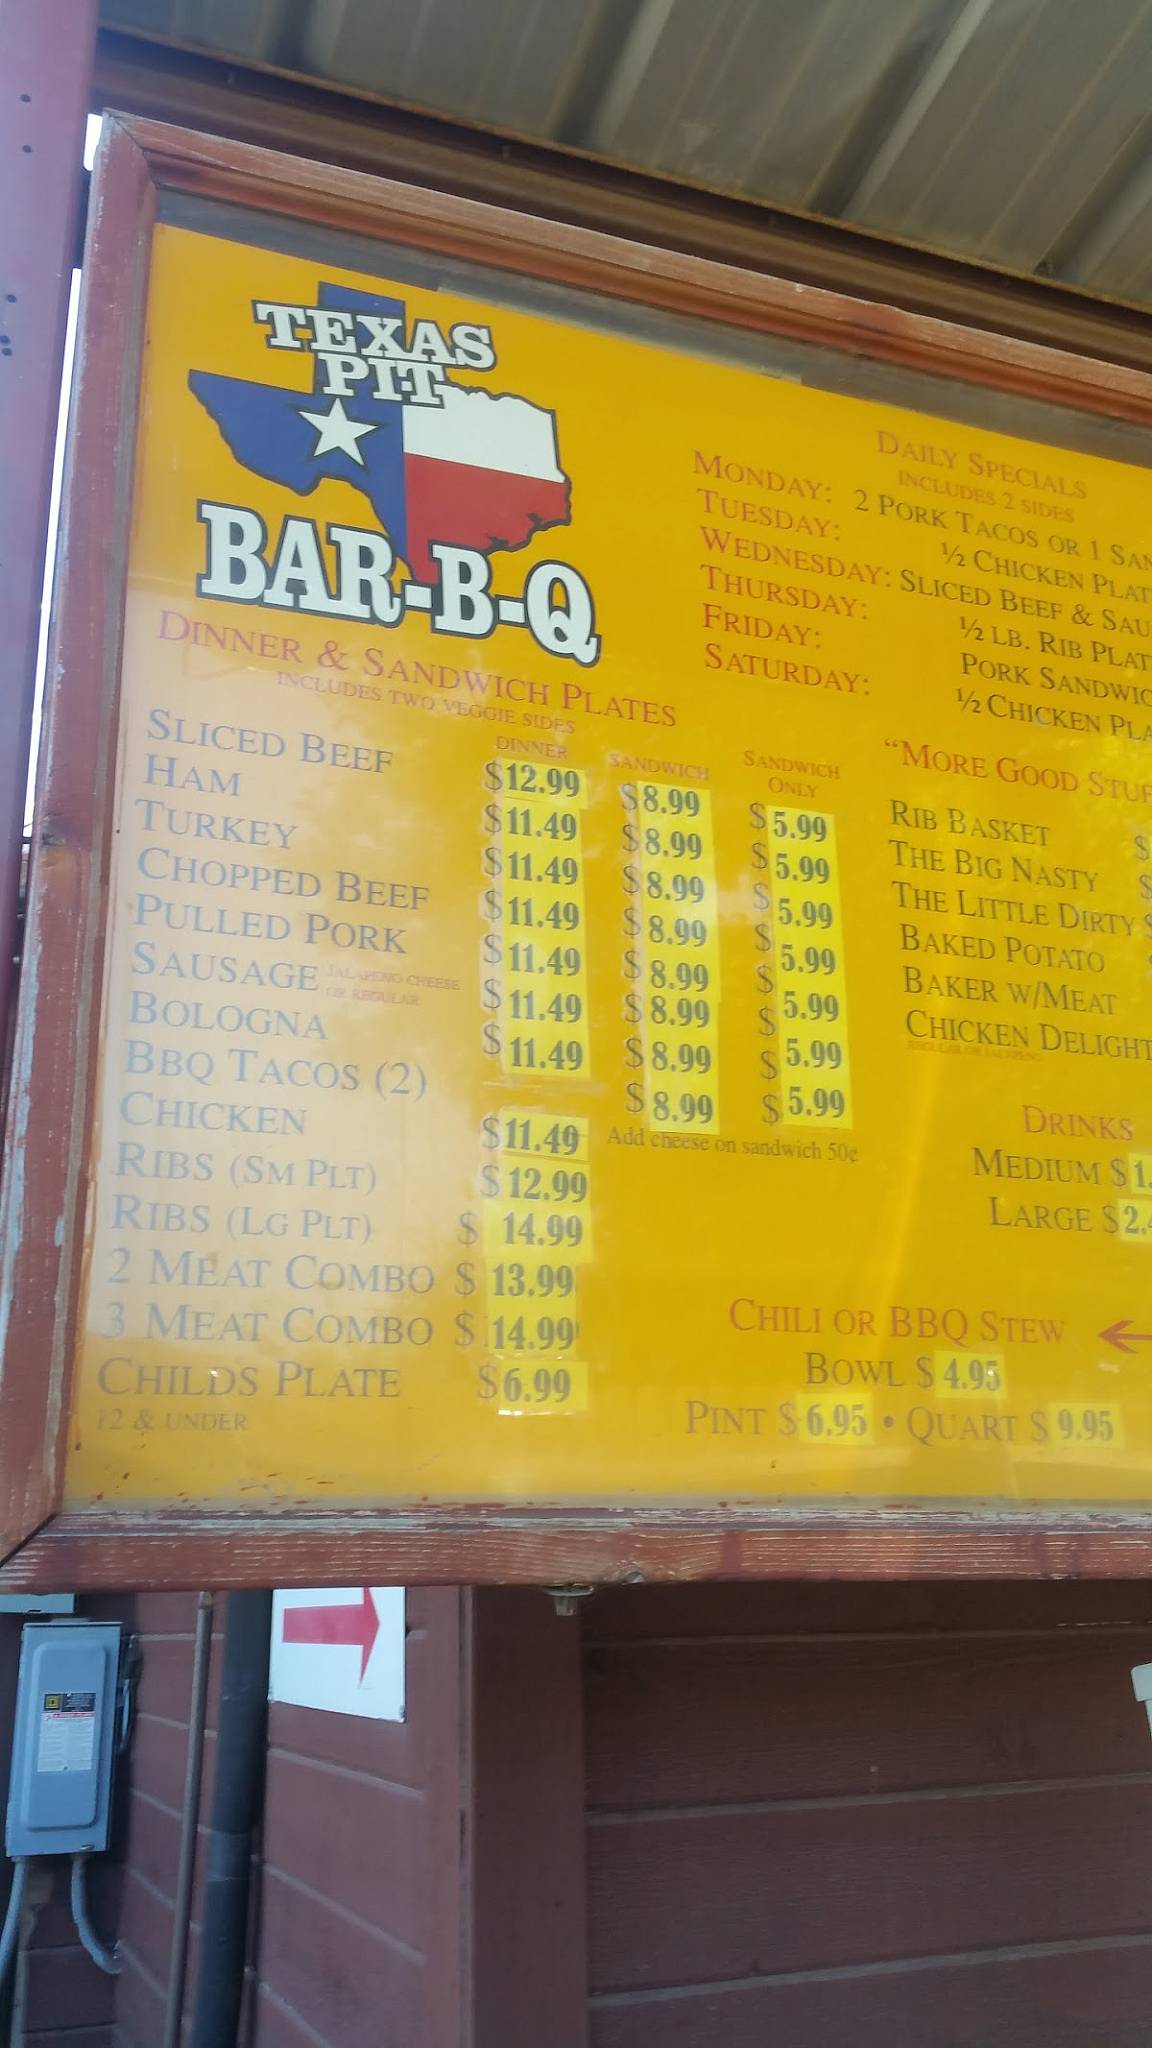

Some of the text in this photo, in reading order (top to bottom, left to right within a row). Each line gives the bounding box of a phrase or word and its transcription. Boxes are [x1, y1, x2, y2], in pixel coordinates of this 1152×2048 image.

[254, 300, 495, 369] TEXAS
[317, 351, 446, 407] PIT
[693, 450, 833, 503] MONDAY:
[878, 430, 1087, 499] DAILY SPECIALS
[696, 488, 841, 541] TUESDAY:
[898, 470, 1075, 523] INCLUDES 2 SIDES
[854, 489, 870, 511] 2
[878, 493, 948, 530] PORK
[955, 511, 1039, 549] TACOS
[1048, 534, 1081, 557] OR
[197, 500, 601, 666] BAR-B-Q
[699, 526, 892, 588] WEDNESDAY:
[900, 569, 991, 608] SLICED
[1000, 589, 1062, 626] BEEF
[1072, 604, 1093, 627] &
[699, 564, 869, 621] THURSDAY:
[973, 549, 1084, 593] CHICKEN
[702, 603, 821, 650] FRIDAY:
[991, 625, 1030, 650] LB.
[1039, 631, 1082, 660] RIB
[158, 609, 677, 727] DINNER & SANDWICH PLATES
[705, 643, 870, 696] SATURDAY:
[960, 652, 1030, 688] PORK
[277, 672, 576, 734] INCLUDES TWO VEGGIE SIDES
[987, 694, 1101, 734] CHICKEN
[148, 708, 393, 774] SLICED BEEF
[496, 735, 568, 760] DINNER
[144, 753, 240, 796] HAM
[608, 752, 710, 782] SANDWICH
[743, 750, 840, 780] SANDWICH
[767, 776, 818, 799] ONLY
[996, 757, 1078, 792] GOOD
[136, 799, 298, 849] TURKEY
[890, 800, 937, 831] RIB
[948, 808, 1050, 847] BASKET
[138, 847, 430, 910] CHOPPED BEEF
[888, 838, 945, 872] THE
[955, 849, 1002, 881] BIG
[1012, 856, 1099, 892] NASTY
[134, 892, 407, 954] PULLED PORK
[892, 880, 948, 914] THE
[957, 889, 1049, 927] LITTLE
[1058, 902, 1135, 936] DIRTY
[131, 941, 320, 991] SAUSAGE
[899, 923, 1106, 974] BAKED POTATO
[903, 965, 998, 1004] BAKER
[129, 990, 329, 1040] BOLOGNA
[906, 1010, 1029, 1048] CHICKEN
[228, 1048, 359, 1090] TACOS
[375, 1061, 427, 1101] (2)
[120, 1091, 308, 1135] CHICKEN
[1022, 1105, 1134, 1141] DRINKS
[115, 1141, 213, 1182] RIBS
[607, 1127, 645, 1146] Add
[651, 1131, 709, 1152] cheese
[715, 1139, 736, 1154] on
[742, 1138, 821, 1160] sandwich
[972, 1147, 1100, 1184] MEDIUM
[110, 1194, 209, 1233] RIBS
[988, 1196, 1152, 1234] LARGE $2.
[107, 1248, 434, 1294] 2 MEAT COMBO
[103, 1302, 433, 1346] 3 MEAT COMBO
[729, 1298, 1066, 1347] CHILI OR BBQ STEW
[97, 1357, 400, 1398] CHILDS PLATE
[805, 1352, 904, 1387] BOWL
[134, 1408, 154, 1431] &
[166, 1412, 249, 1431] UNDER
[686, 1401, 767, 1435] PINT
[906, 1406, 1019, 1445] QUART
